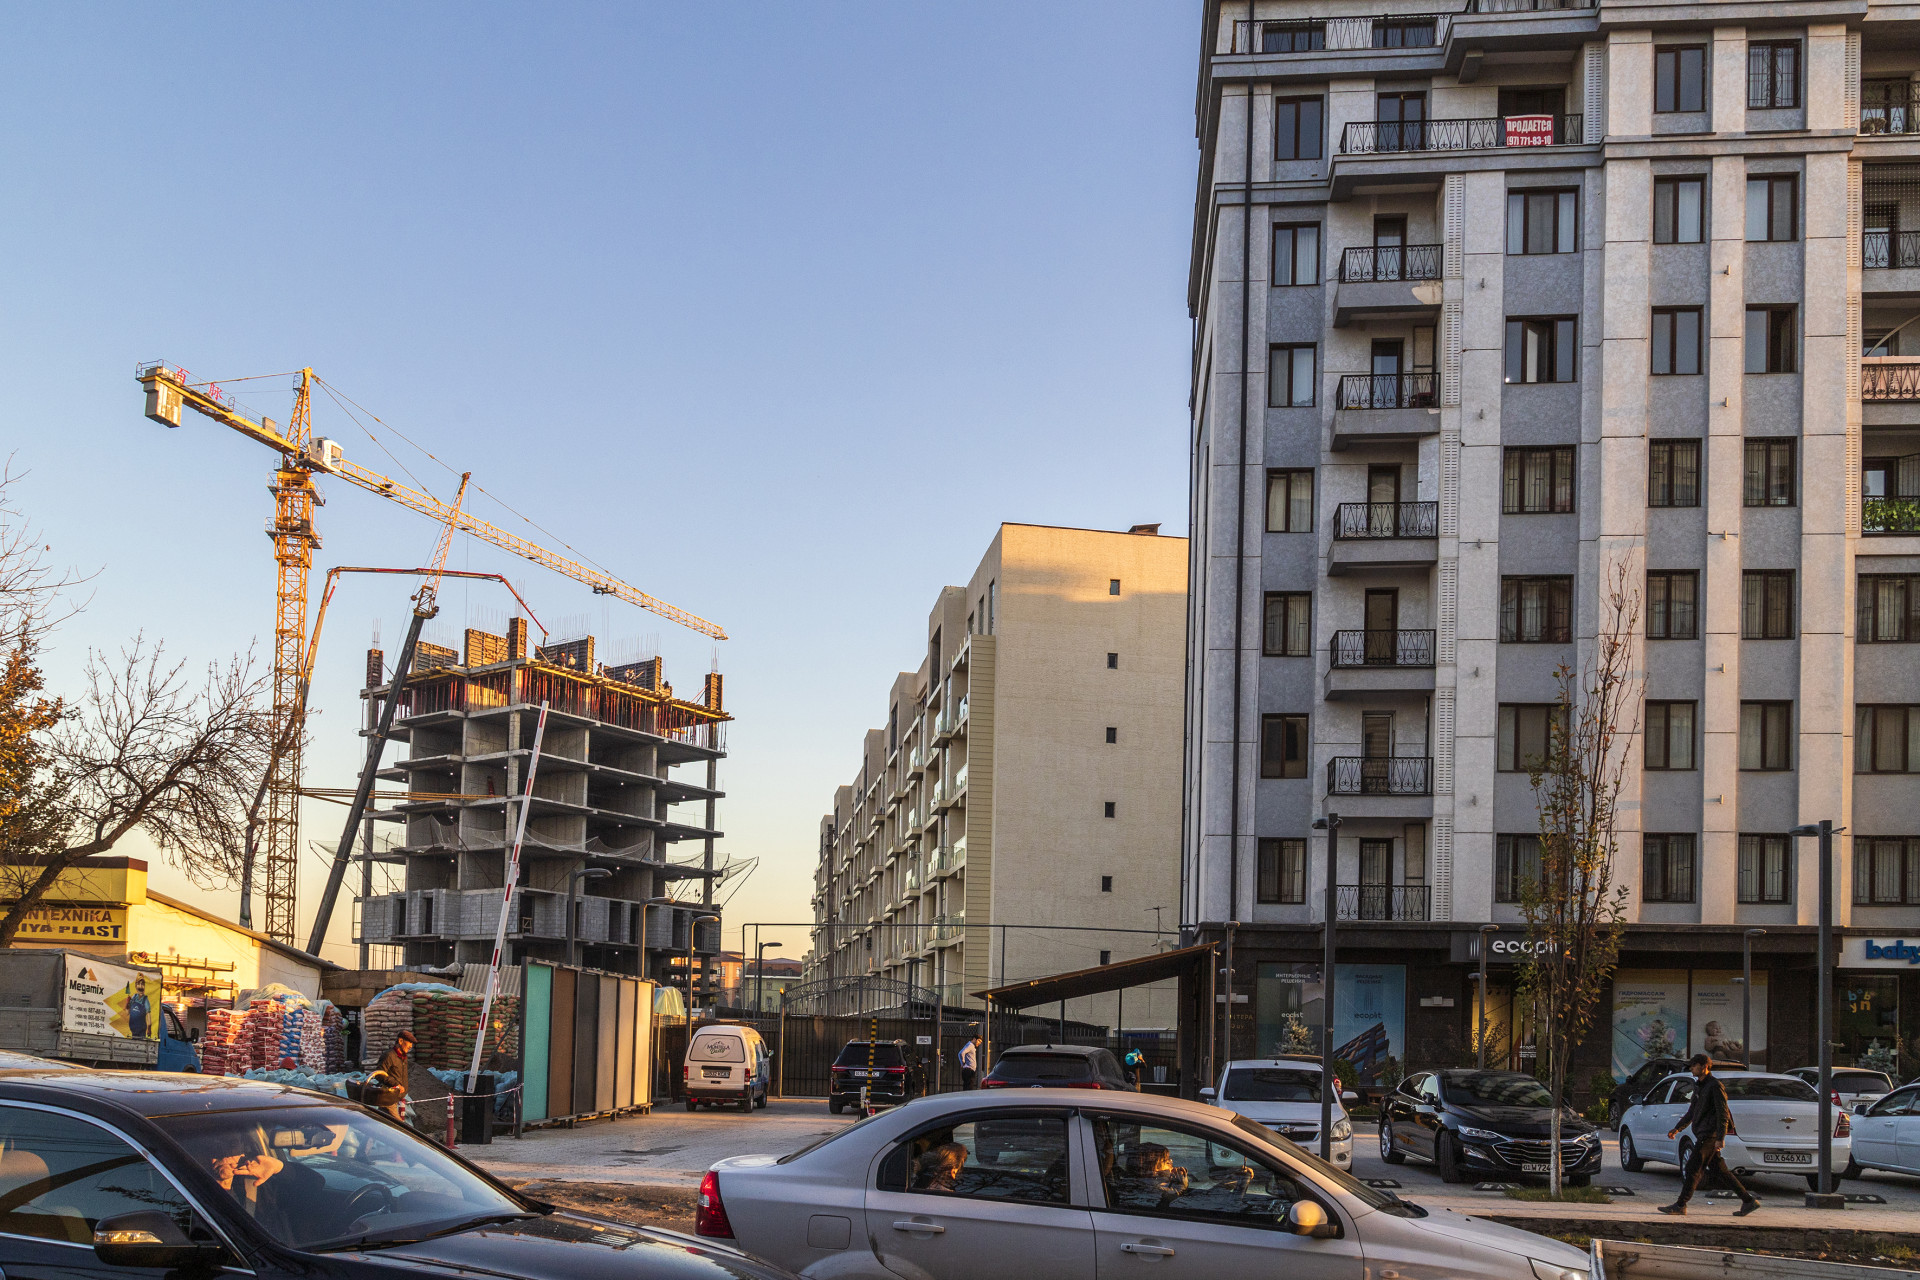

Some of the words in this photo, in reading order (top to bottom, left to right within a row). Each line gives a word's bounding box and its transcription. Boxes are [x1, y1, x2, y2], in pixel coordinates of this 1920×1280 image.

[1507, 120, 1551, 133] ПРОДАЕТСЯ
[59, 925, 122, 938] PLAST
[69, 980, 104, 995] Megamix
